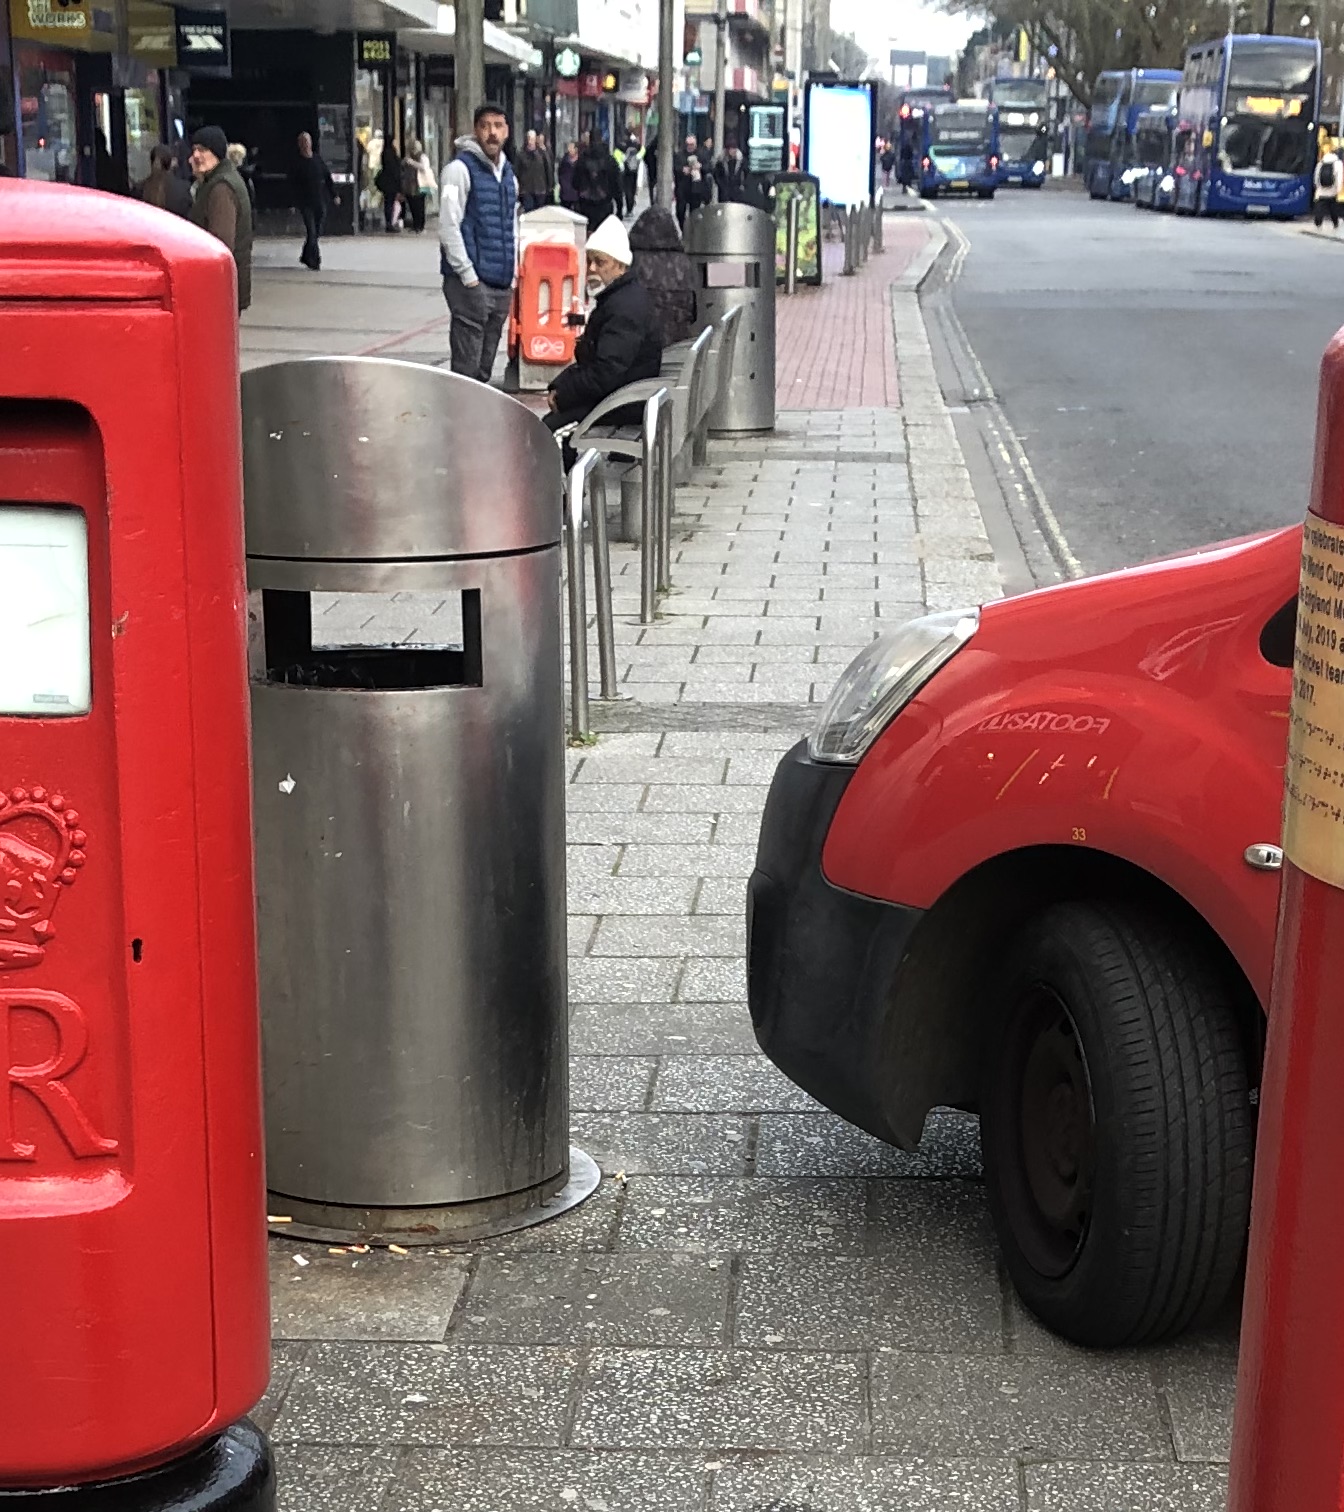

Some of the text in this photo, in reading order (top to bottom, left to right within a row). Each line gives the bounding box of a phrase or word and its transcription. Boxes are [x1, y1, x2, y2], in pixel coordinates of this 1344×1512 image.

[29, 11, 86, 28] WORKS
[1326, 563, 1344, 592] Cup
[1316, 624, 1337, 650] 2019
[1072, 827, 1086, 841] 33
